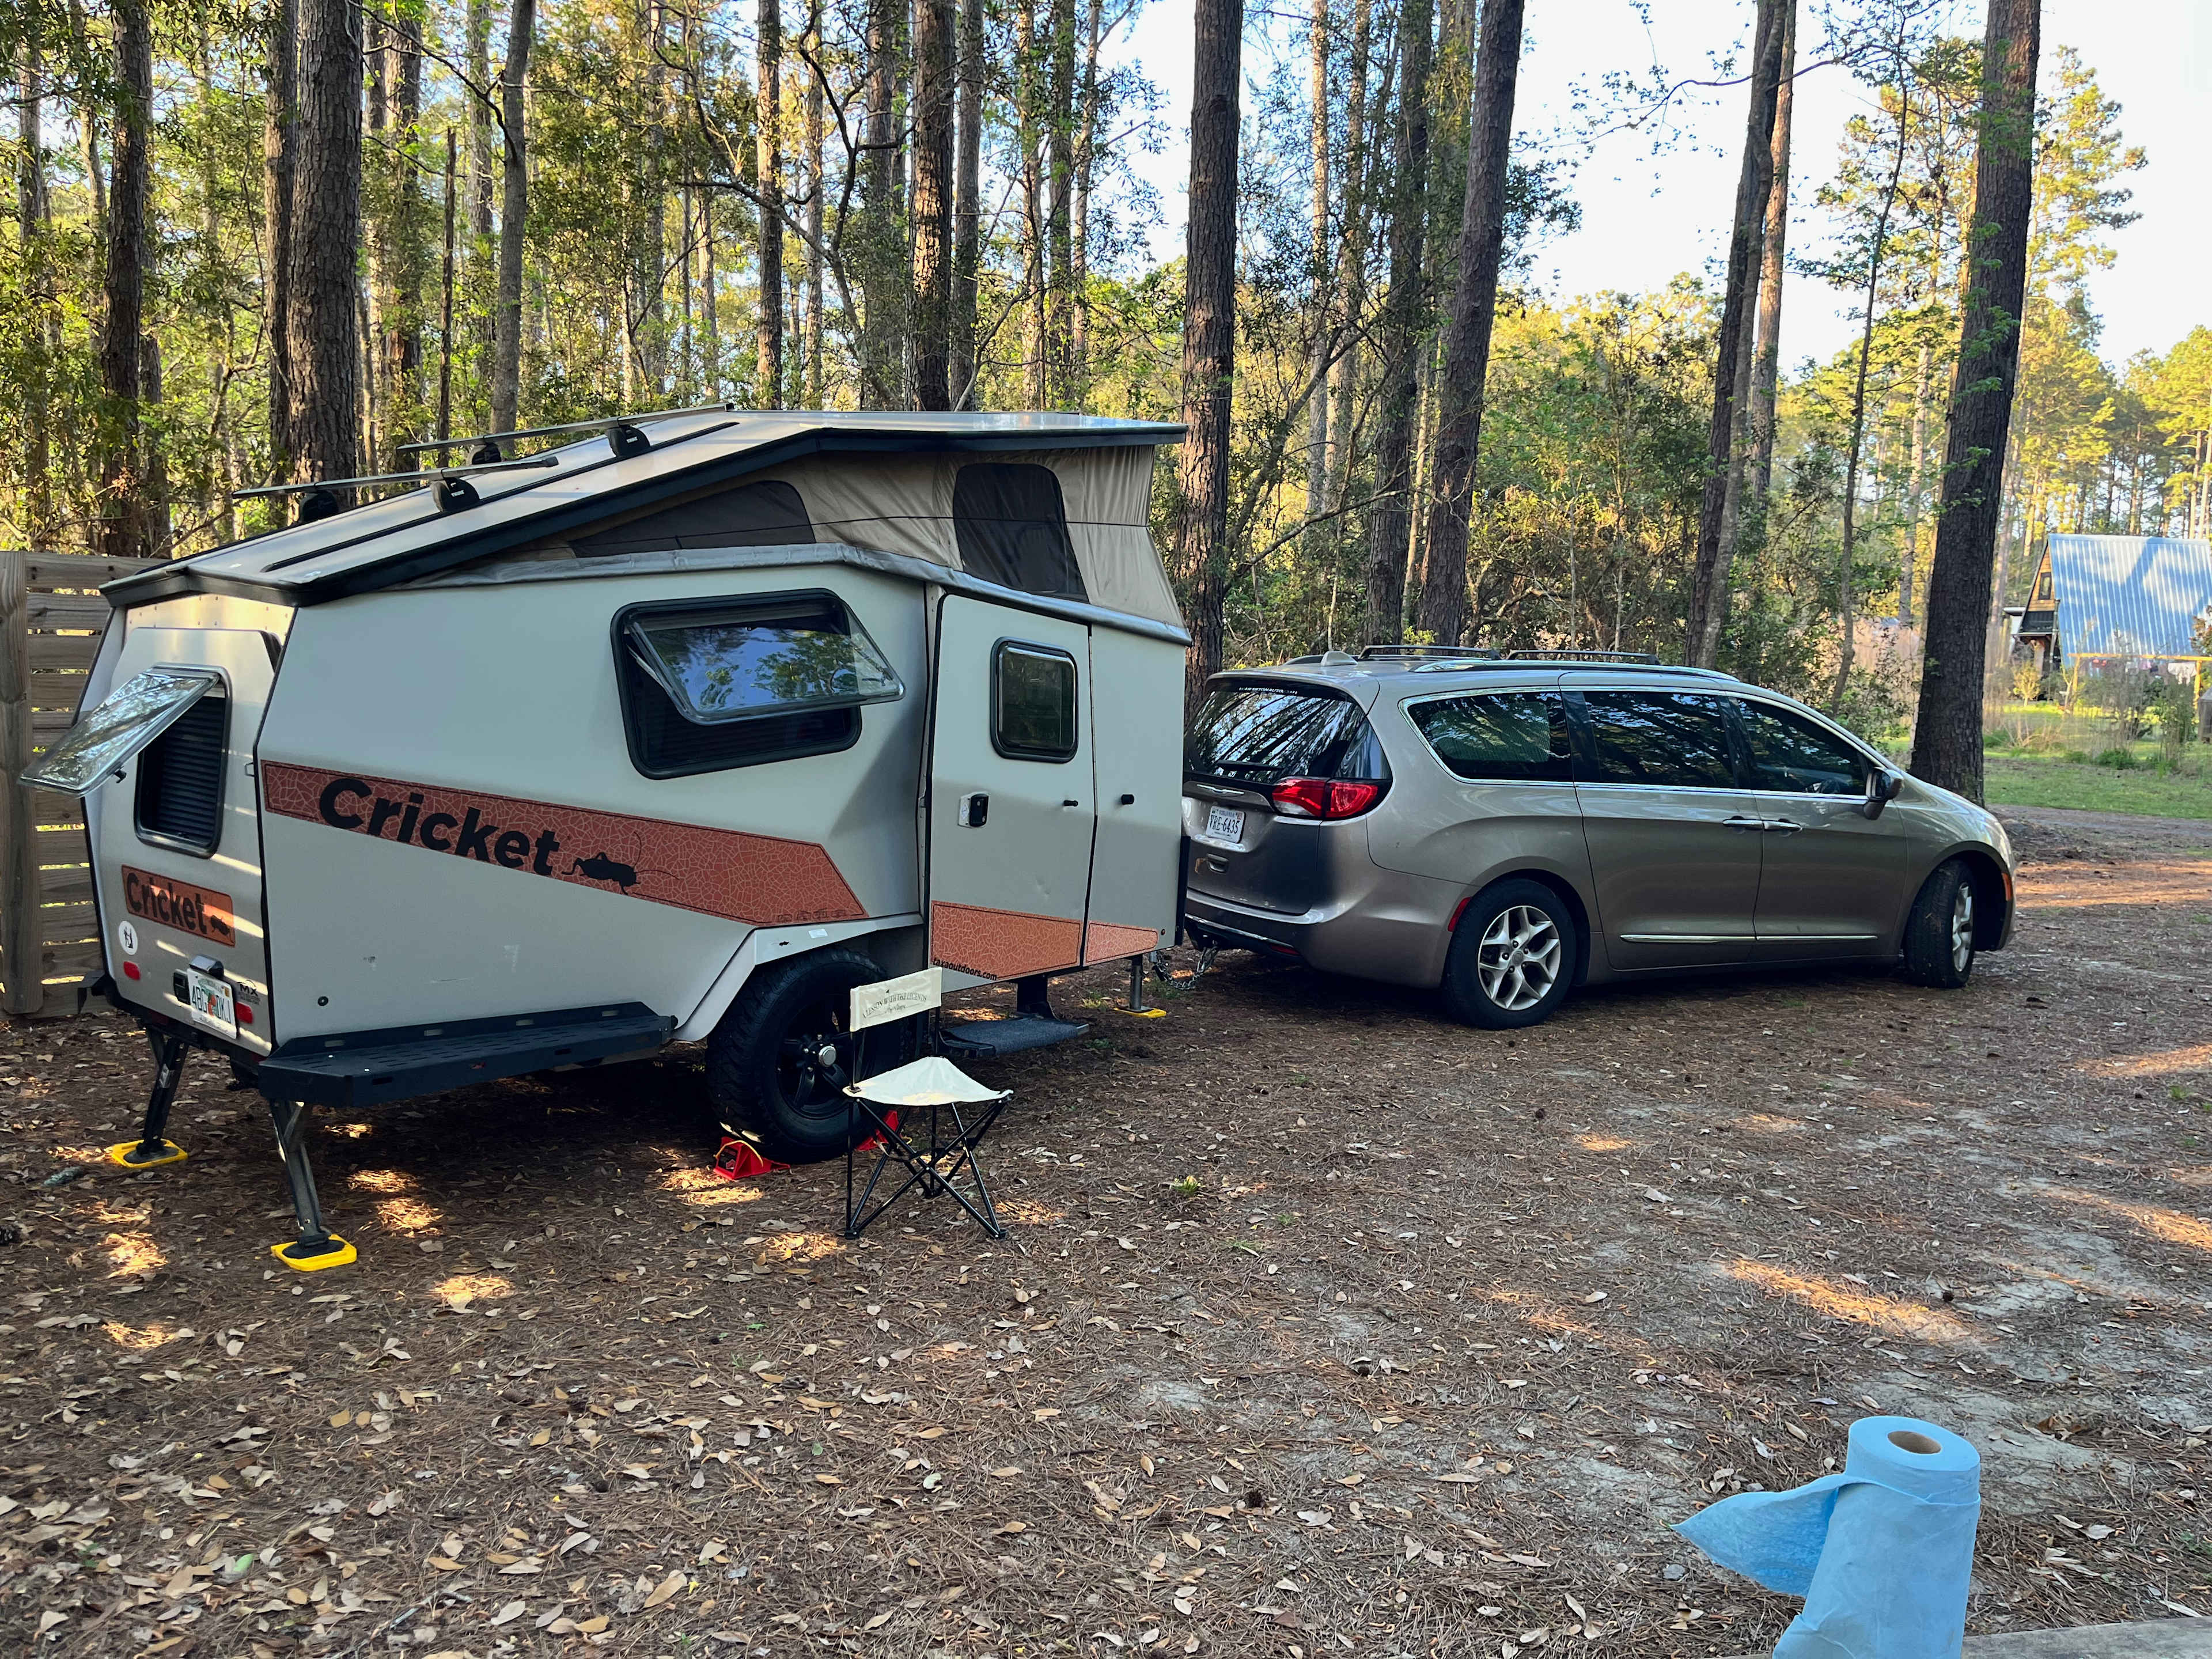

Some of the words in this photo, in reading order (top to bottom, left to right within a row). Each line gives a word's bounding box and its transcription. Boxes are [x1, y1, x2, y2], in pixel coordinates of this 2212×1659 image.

[319, 778, 560, 876] Cricket
[1210, 815, 1240, 834] VRE-6435
[127, 873, 207, 934] Cricket
[933, 957, 997, 981] taxaoutdoors.com
